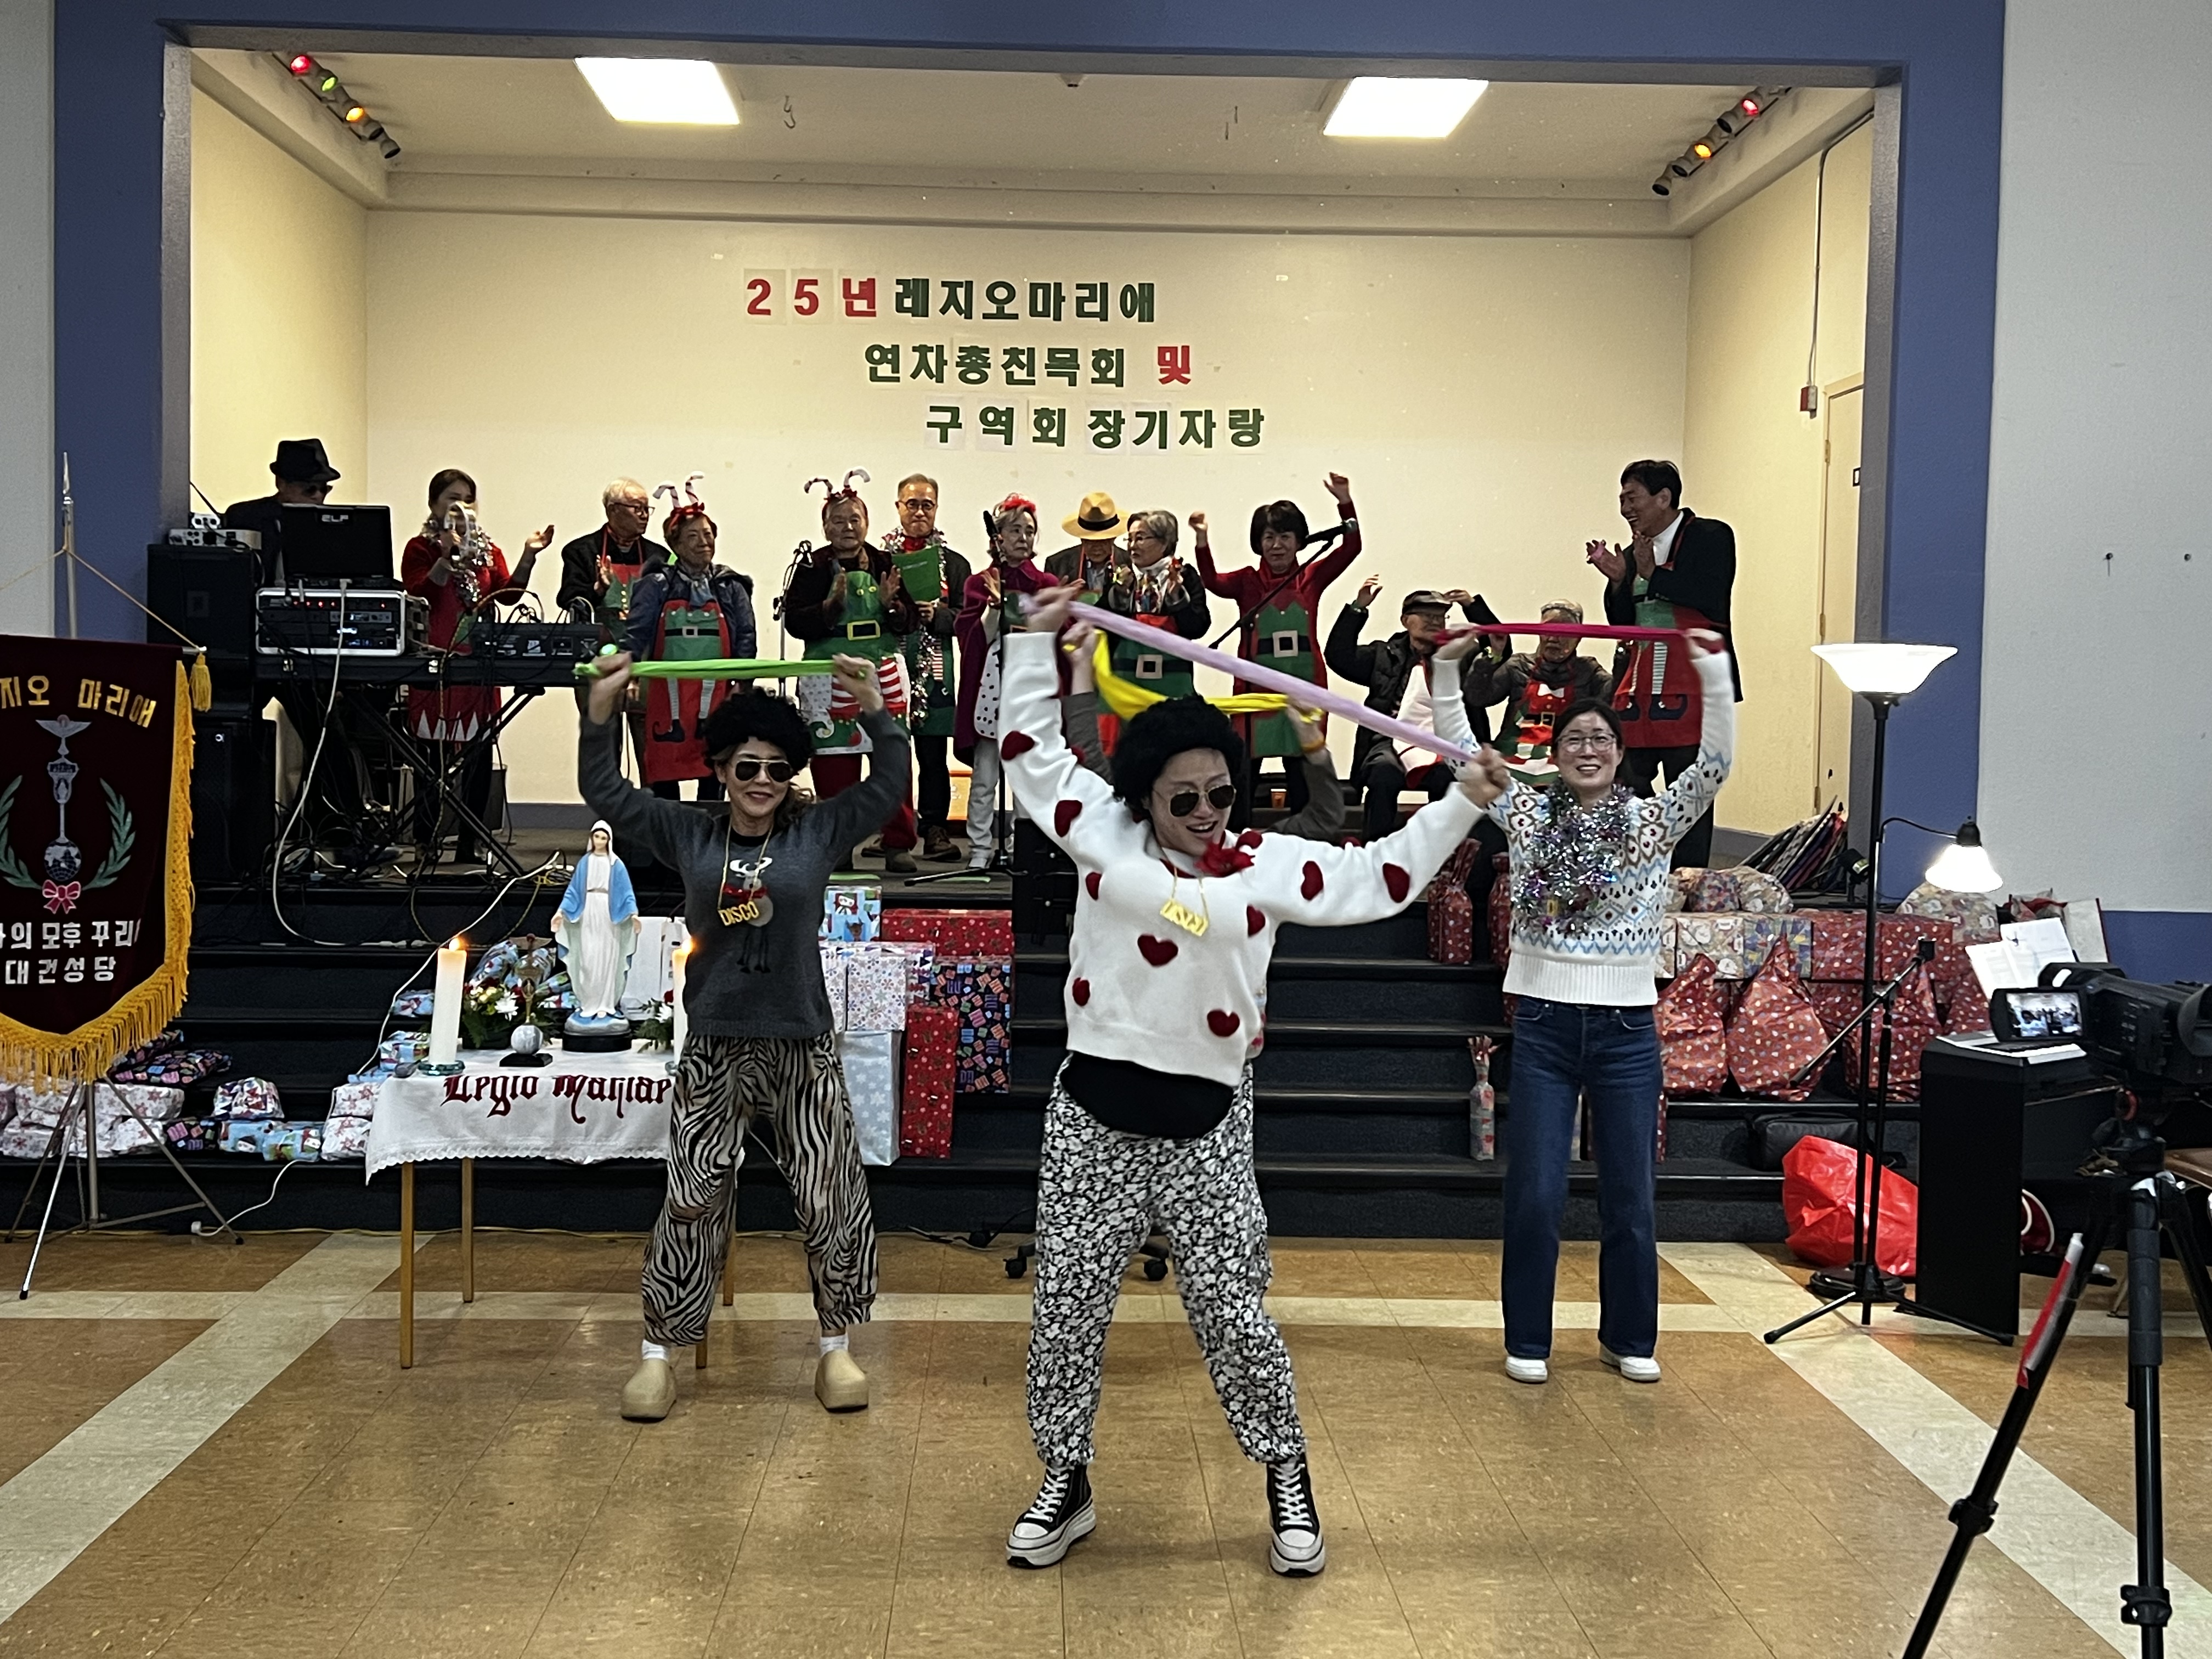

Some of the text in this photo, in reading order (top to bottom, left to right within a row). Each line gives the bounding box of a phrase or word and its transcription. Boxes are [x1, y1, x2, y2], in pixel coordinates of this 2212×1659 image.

[1157, 345, 1191, 384] 및
[1087, 408, 1265, 449] 장기자랑
[77, 679, 157, 728] 마리애
[718, 901, 759, 926] DISCO
[42, 922, 81, 950] 모후
[5, 956, 116, 985] 대건성당
[440, 1074, 539, 1118] Legio
